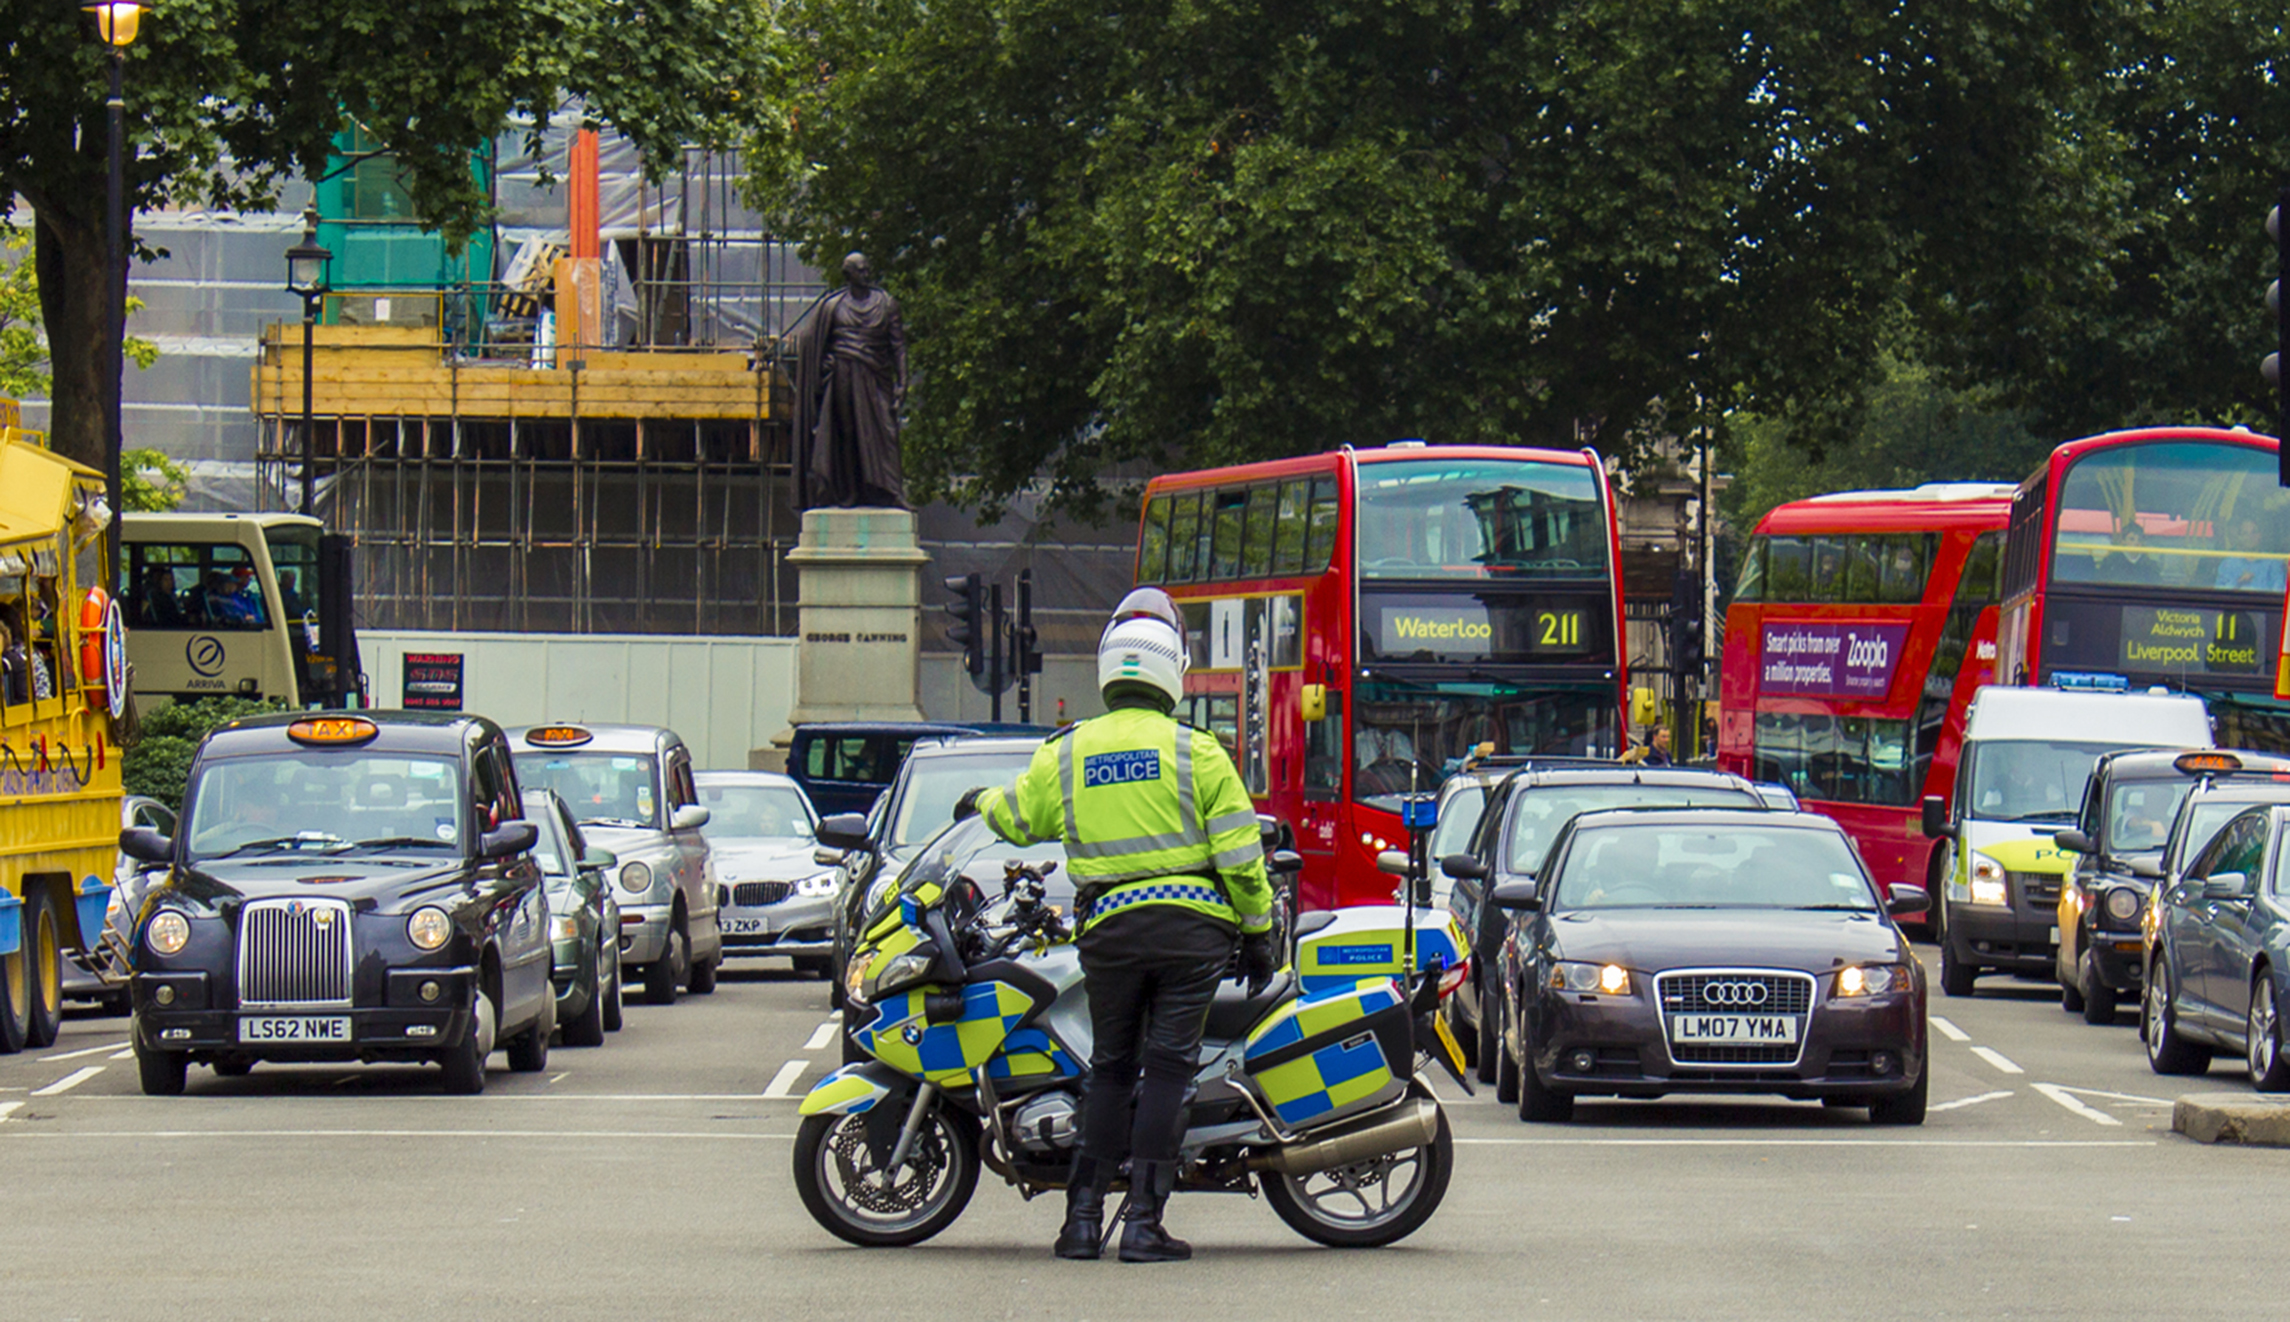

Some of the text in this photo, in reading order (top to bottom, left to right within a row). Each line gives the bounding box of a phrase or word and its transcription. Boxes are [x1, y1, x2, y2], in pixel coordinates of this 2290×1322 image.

[2157, 610, 2201, 624] Victoria
[1394, 616, 1492, 638] Waterloo
[1539, 612, 1578, 645] 211
[2151, 623, 2205, 638] Aldwych
[2217, 613, 2237, 640] 11
[806, 633, 907, 643] GEORGE CANNING
[1767, 631, 1841, 656] Smart picks from over
[406, 654, 460, 665] WARNING
[1847, 632, 1888, 674] Zoopla
[2127, 640, 2255, 666] Liverpool Street
[1765, 665, 1769, 681] a
[1771, 660, 1793, 681] million
[186, 680, 226, 690] ARRIVA
[305, 722, 358, 737] TAXI
[1085, 750, 1158, 766] METROPOLITAN
[1085, 760, 1159, 785] POLICE
[2035, 850, 2077, 860] PO
[735, 920, 761, 932] ZKP
[249, 1020, 343, 1038] LS62 NWE
[1683, 1018, 1786, 1038] LM07 YMA
